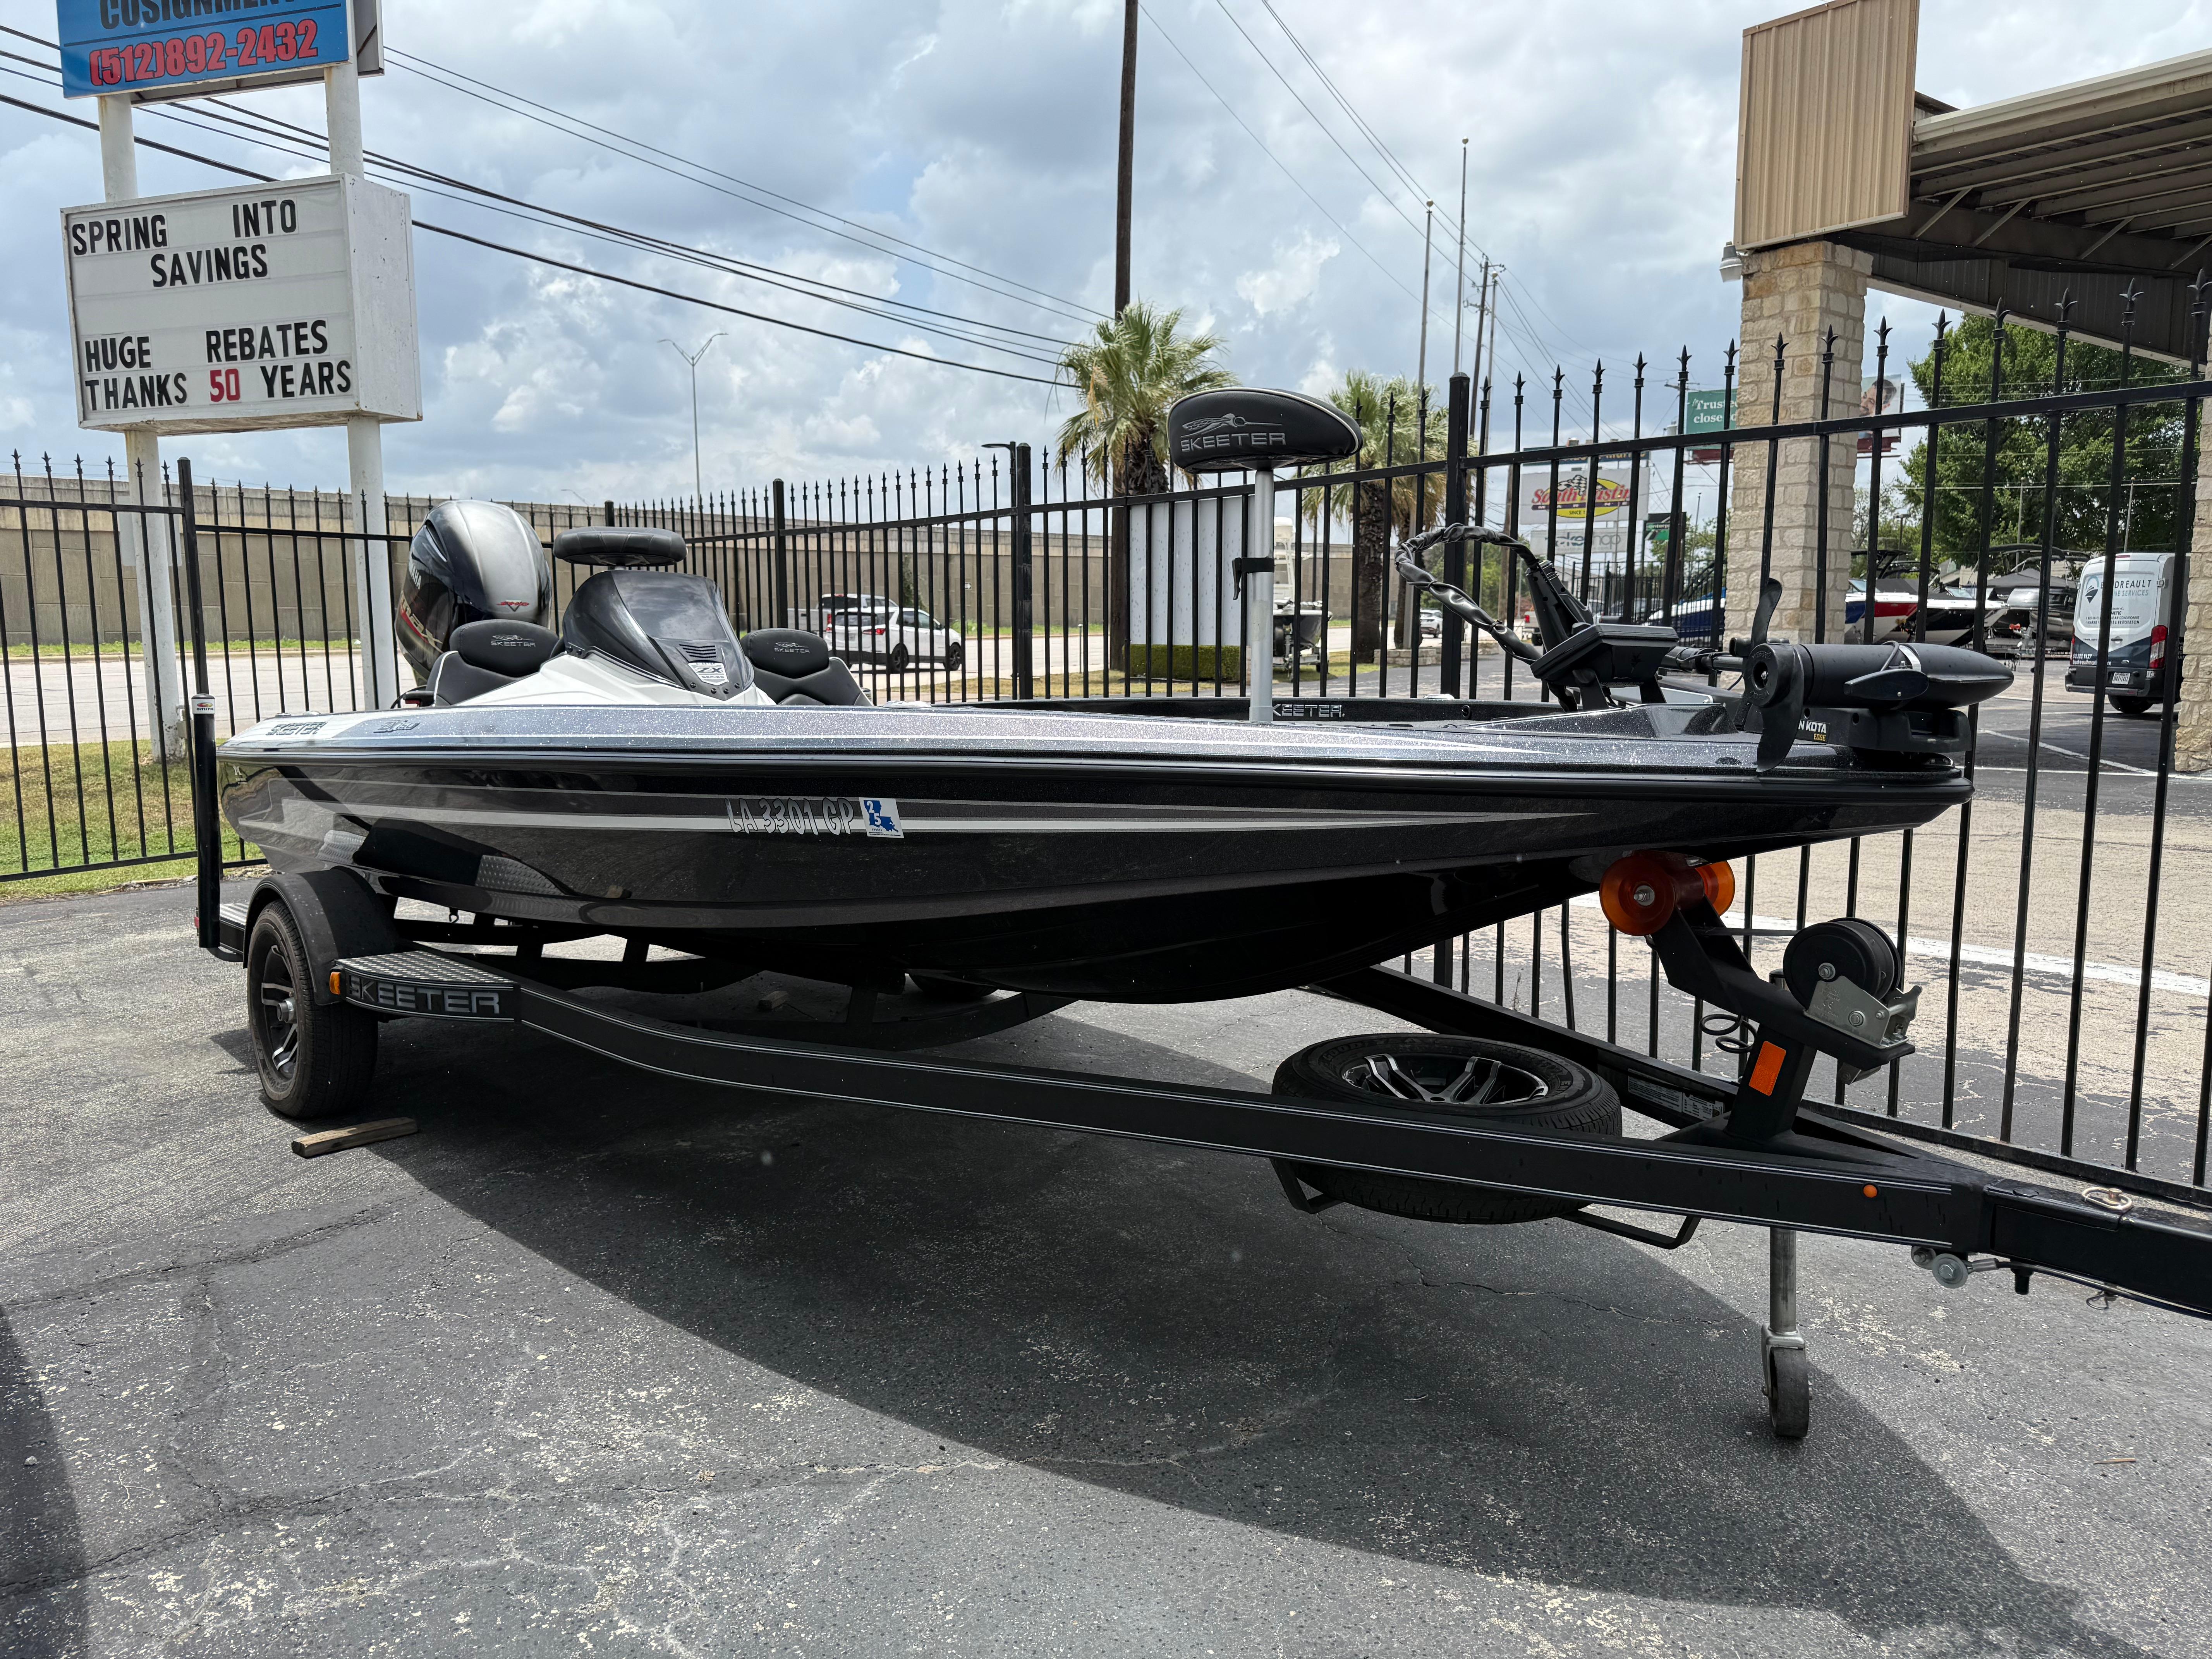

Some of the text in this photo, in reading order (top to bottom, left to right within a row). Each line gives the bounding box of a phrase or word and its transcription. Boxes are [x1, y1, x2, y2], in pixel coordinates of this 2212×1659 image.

[100, 0, 295, 29] COSIG
[89, 19, 318, 86] (512)892-2432
[73, 199, 297, 256] SPRING INTO
[153, 244, 268, 287] SAVINGS
[85, 320, 328, 372] HUGE REBATES
[84, 360, 352, 411] THANKS 50 YEARS
[1693, 399, 1738, 410] Truse
[1693, 413, 1723, 423] close
[1181, 433, 1286, 452] SKEETER
[1581, 484, 1630, 502] ustin
[2100, 580, 2152, 589] BDREAULT
[1273, 704, 1342, 718] KEETER
[266, 721, 328, 736] SKEETER
[1805, 721, 1827, 733] KOTA
[1814, 733, 1826, 741] EDGE
[725, 797, 854, 835] LA 3301 GP
[349, 975, 500, 1014] SKEETER
